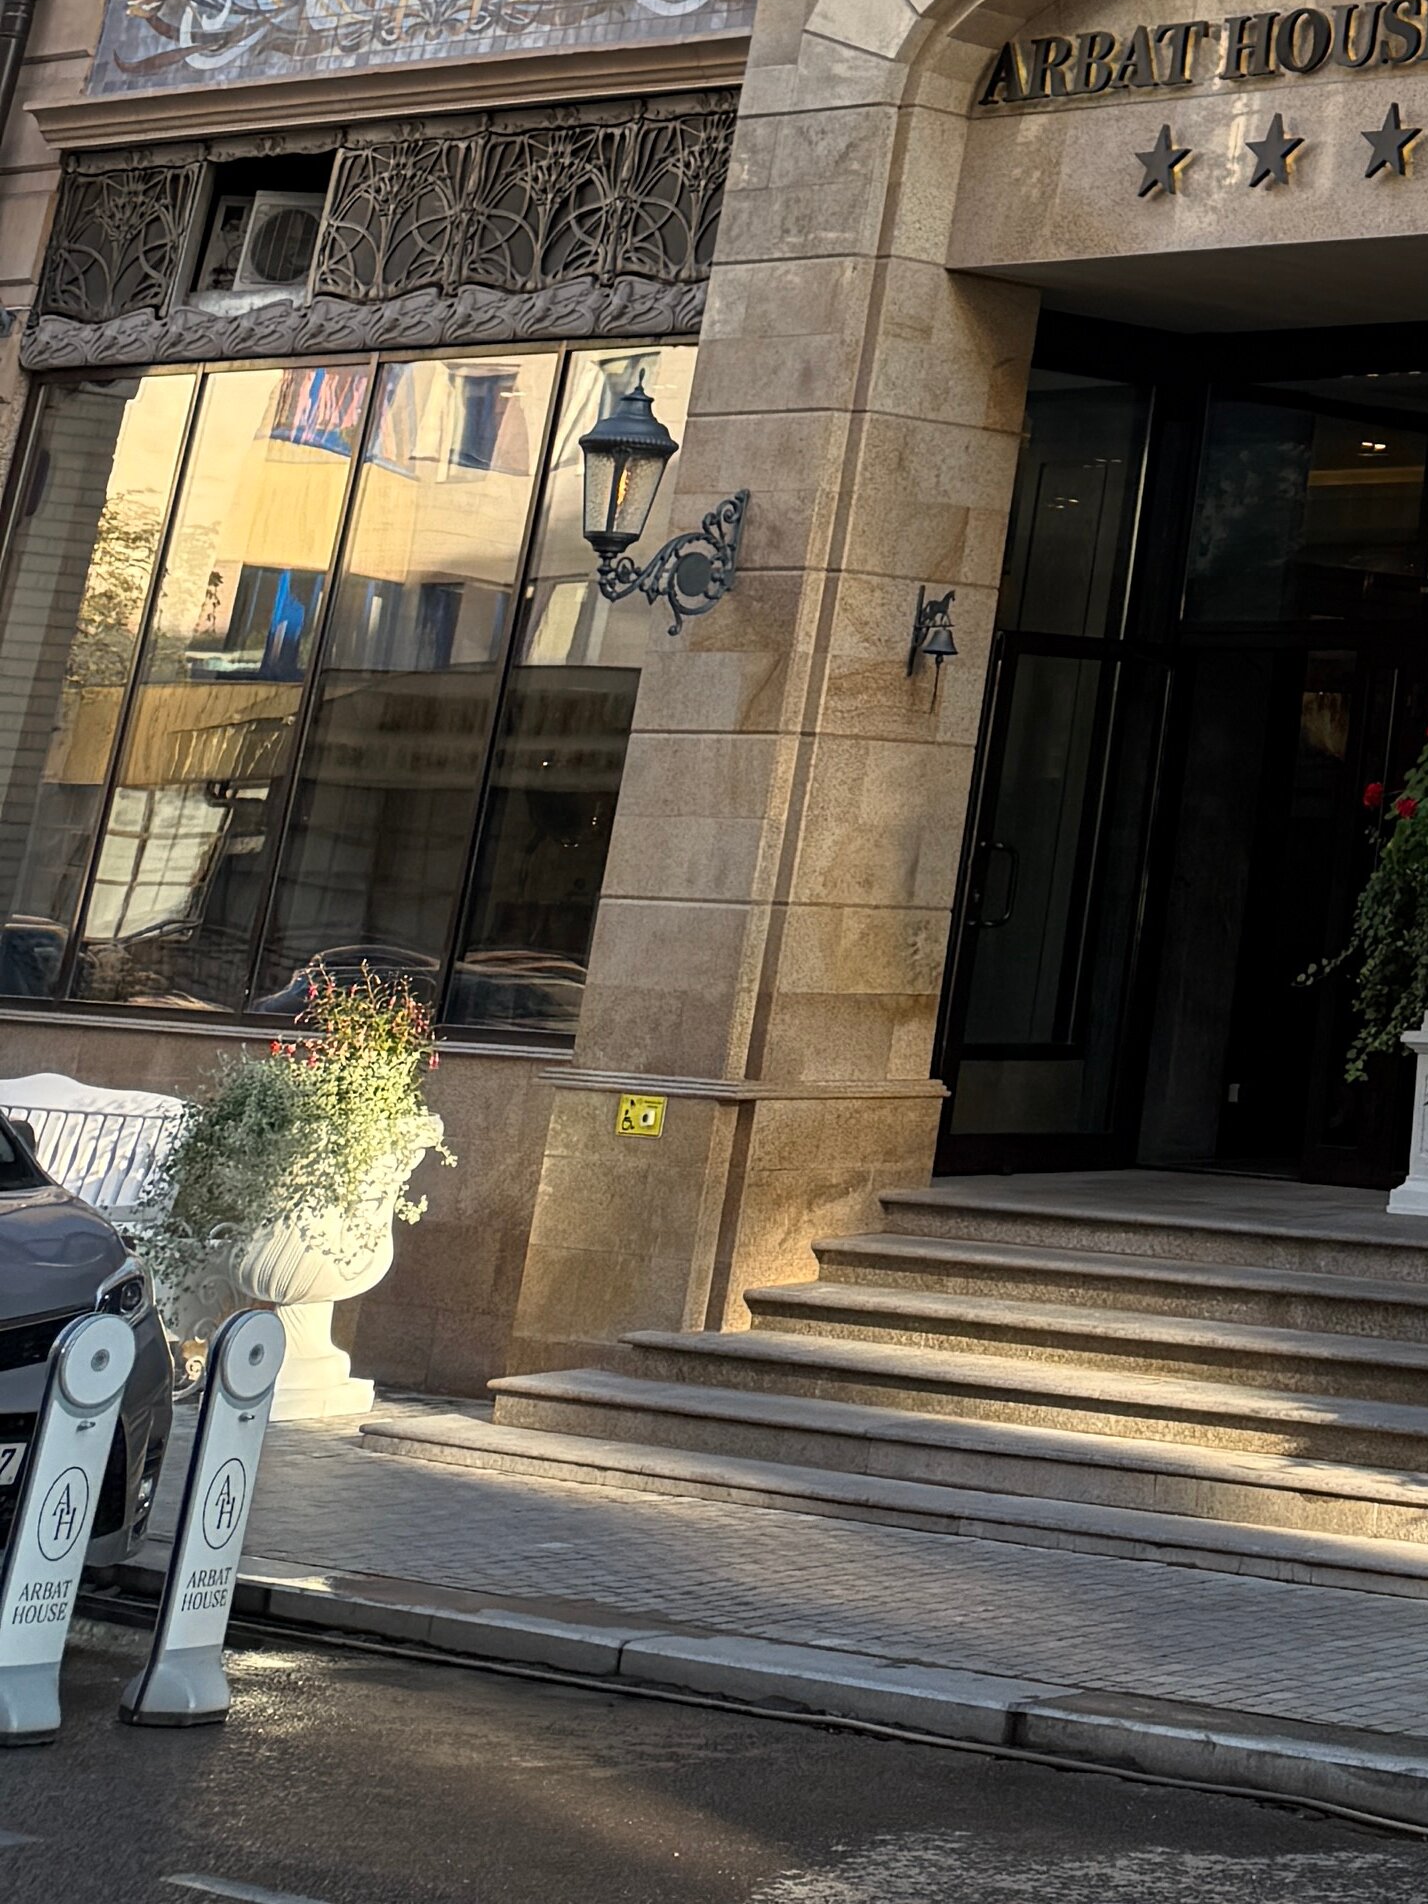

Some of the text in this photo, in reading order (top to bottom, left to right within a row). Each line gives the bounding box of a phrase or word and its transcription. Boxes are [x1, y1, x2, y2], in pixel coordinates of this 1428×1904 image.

[979, 19, 1210, 106] ARBAT
[186, 1567, 232, 1589] ARBAT
[18, 1580, 73, 1602] ARBAT
[181, 1589, 227, 1612] HOUSE
[12, 1602, 68, 1625] HOUSE
